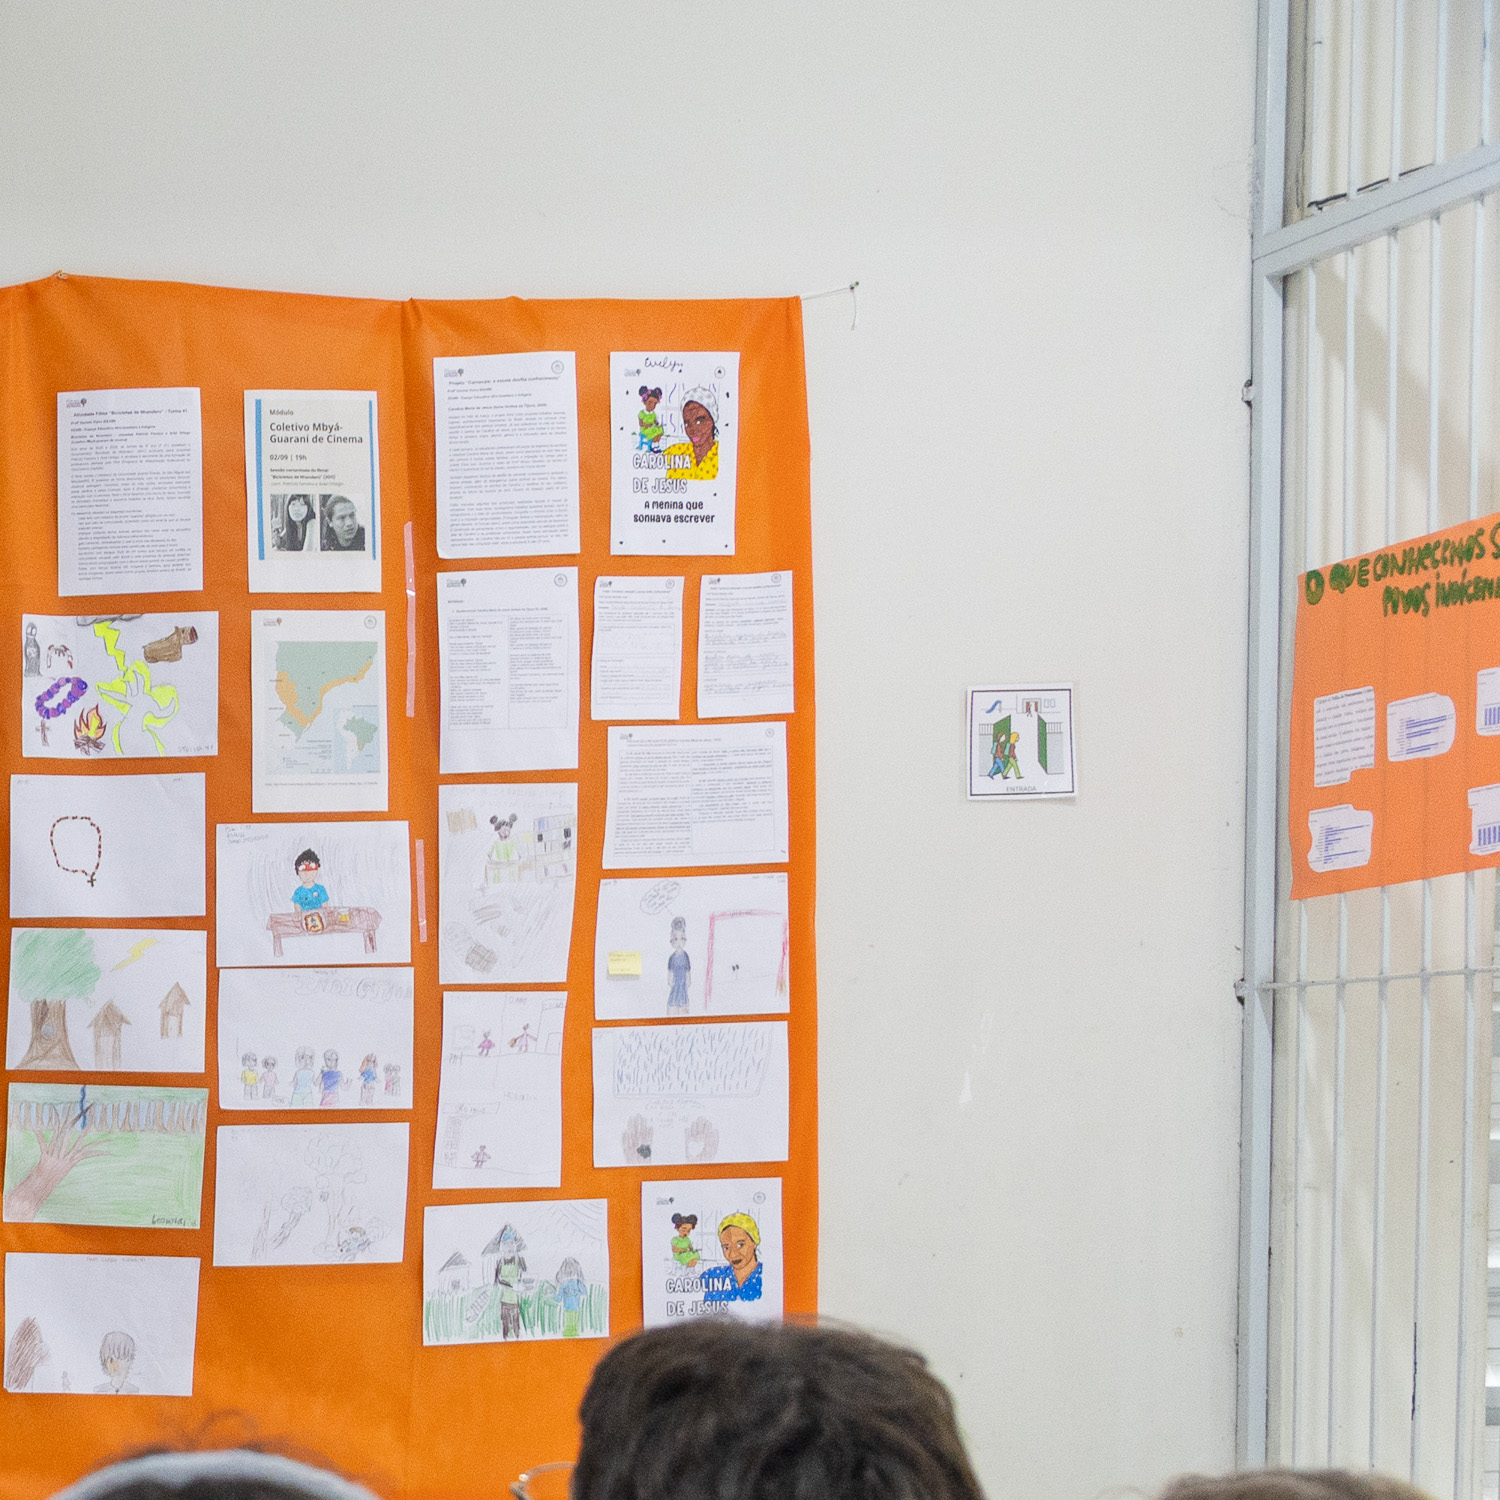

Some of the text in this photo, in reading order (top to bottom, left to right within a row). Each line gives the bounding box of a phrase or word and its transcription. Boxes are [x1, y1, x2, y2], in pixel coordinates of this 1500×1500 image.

[270, 422, 343, 433] Coletivo Mbyá-
[270, 434, 363, 444] Guarani de Cinema
[633, 454, 692, 470] CAROLINA
[633, 477, 688, 494] DE JESUS
[644, 501, 650, 510] A
[1305, 570, 1325, 606] O
[1329, 558, 1371, 594] QUE
[666, 1278, 732, 1294] CAROLINA
[666, 1300, 729, 1317] DE JESUS
